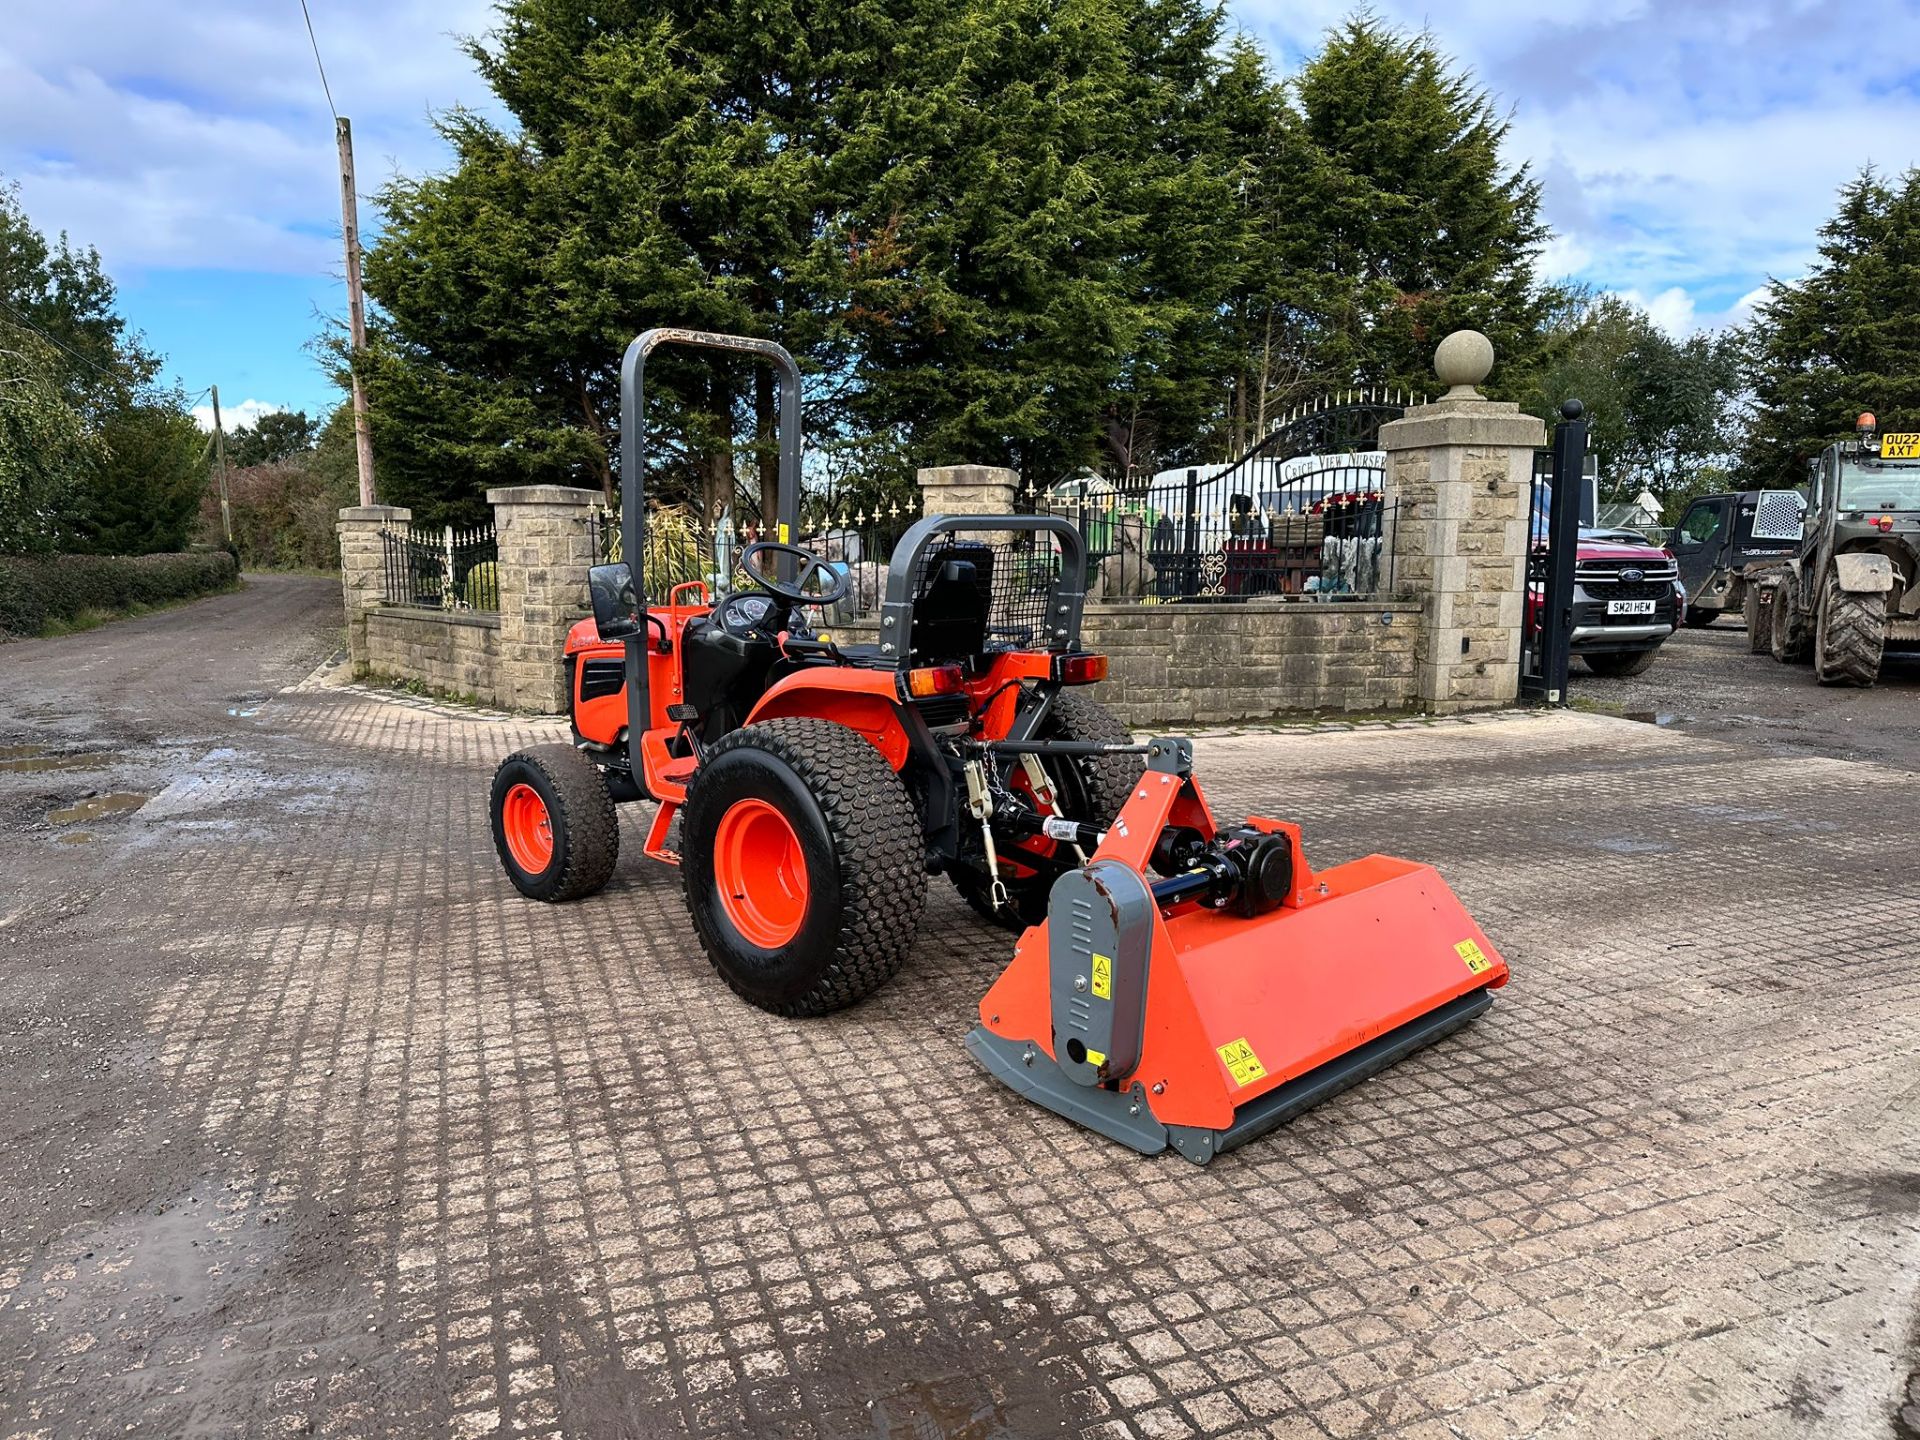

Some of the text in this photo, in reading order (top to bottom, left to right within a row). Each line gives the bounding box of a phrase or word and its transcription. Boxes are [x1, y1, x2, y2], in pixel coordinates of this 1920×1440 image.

[1886, 434, 1919, 445] OU22
[1888, 445, 1912, 456] AXT
[1319, 454, 1343, 469] VIEW
[1613, 602, 1632, 612] SM21
